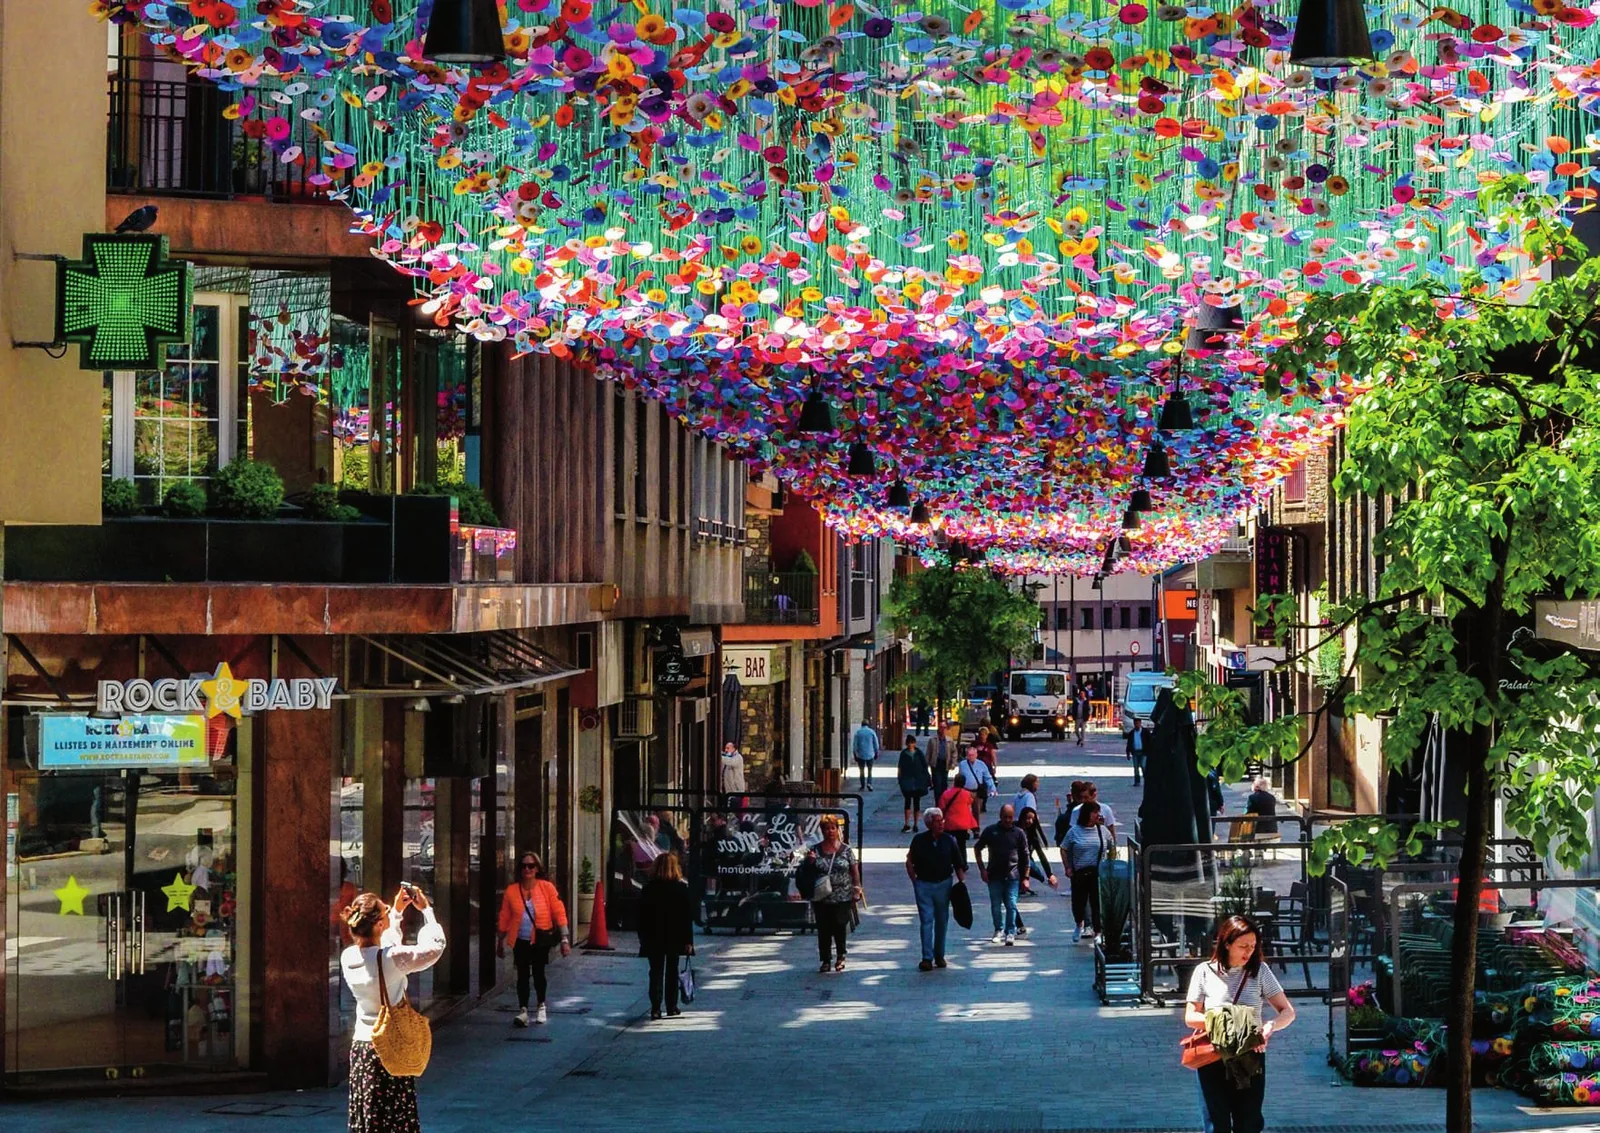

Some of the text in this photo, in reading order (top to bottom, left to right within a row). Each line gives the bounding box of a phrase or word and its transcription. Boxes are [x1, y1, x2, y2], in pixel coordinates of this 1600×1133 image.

[1187, 599, 1198, 608] NE
[745, 657, 765, 678] BAR
[97, 676, 339, 712] ROCK & BABY
[86, 724, 119, 735] ROCK
[55, 740, 194, 750] LLISTES DE NAIXEMENT ONLINE
